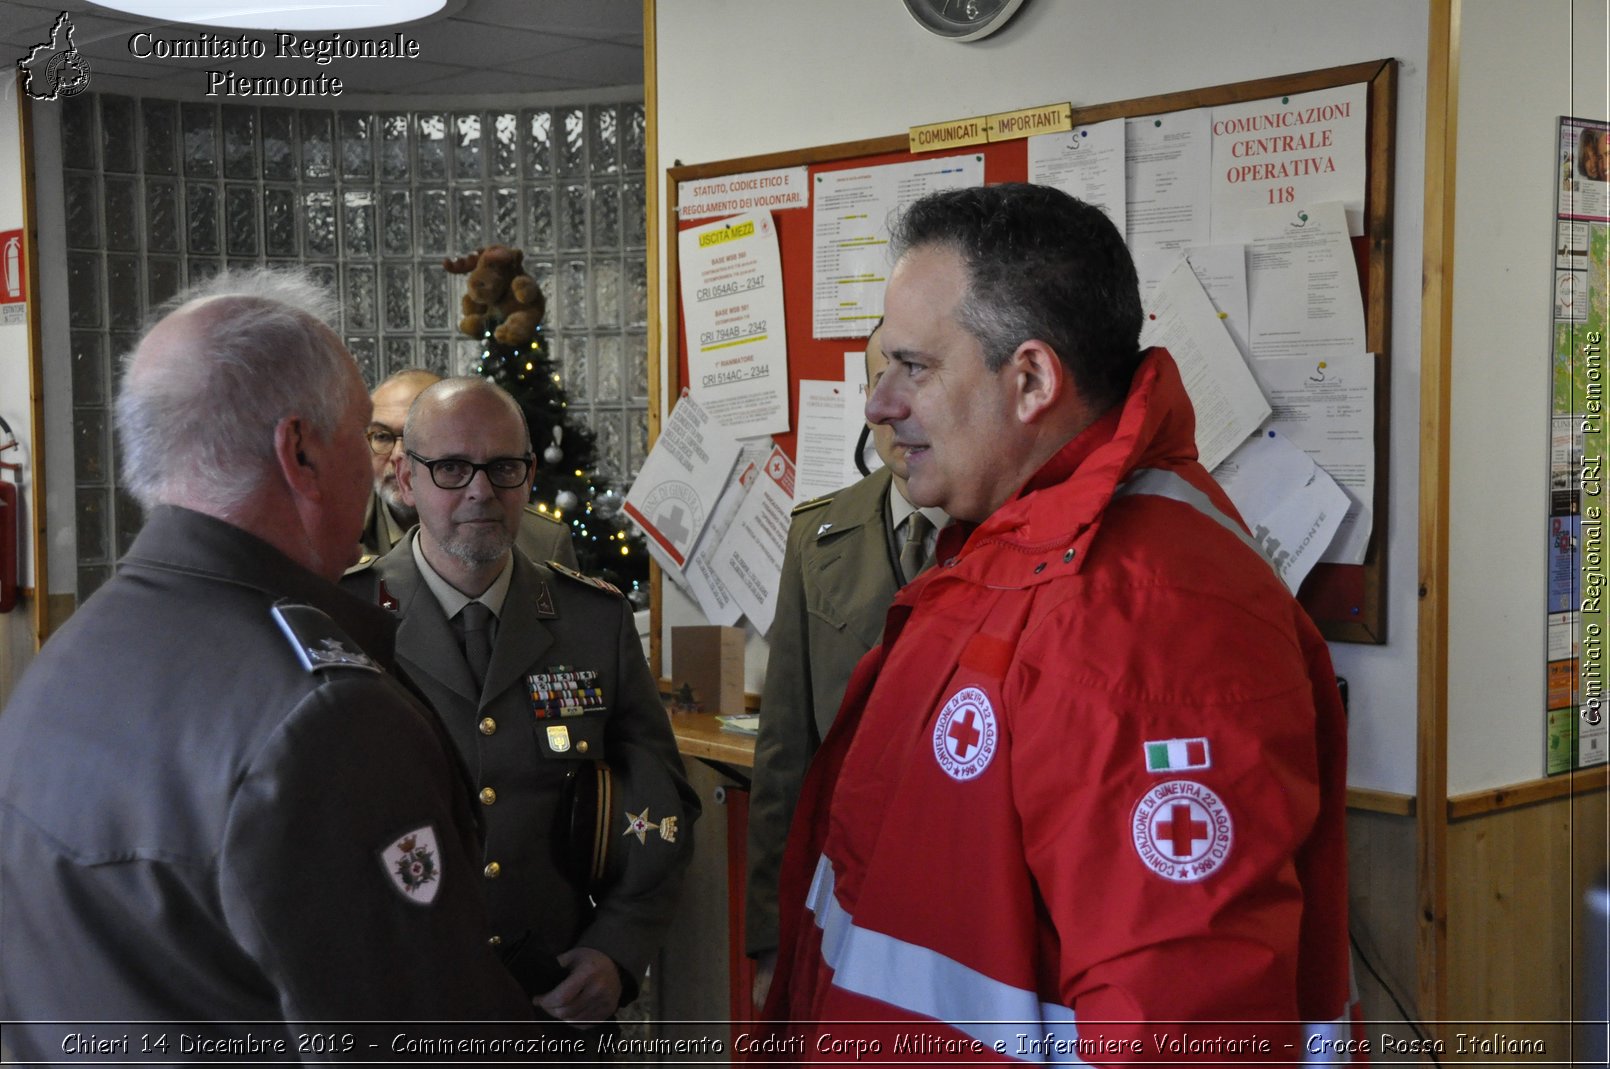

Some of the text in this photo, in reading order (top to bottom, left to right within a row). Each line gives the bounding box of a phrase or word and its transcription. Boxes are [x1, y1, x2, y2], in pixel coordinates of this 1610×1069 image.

[918, 110, 1061, 145] COMUNICATI IMPORTANTI
[1213, 101, 1351, 136] COMUNICAZIONI
[1232, 129, 1333, 158] CENTRALE
[1227, 156, 1336, 184] OPERATIVA
[693, 175, 790, 198] STATUTO, CODICE ETICO E
[1268, 186, 1295, 205] 118
[683, 192, 802, 216] REGOLAMENTO DEI VOLONTARI.
[699, 222, 754, 247] USCITA MEZZI
[697, 287, 711, 300] CRI
[712, 281, 738, 297] 054AG
[747, 275, 765, 289] 2347
[700, 330, 714, 343] CRI
[716, 326, 740, 341] 794AB
[748, 320, 768, 334] 2342
[702, 374, 716, 386] CRI
[717, 368, 742, 383] 514AC
[750, 364, 769, 377] 2344
[1282, 512, 1326, 576] PIEMONTE
[935, 690, 994, 777] CONVENZIONE DI GINEVRA 22 AGOSTO 1864
[1136, 783, 1229, 876] CONVENZIONE DI GINEVRA 22 AGOSTO 1864
